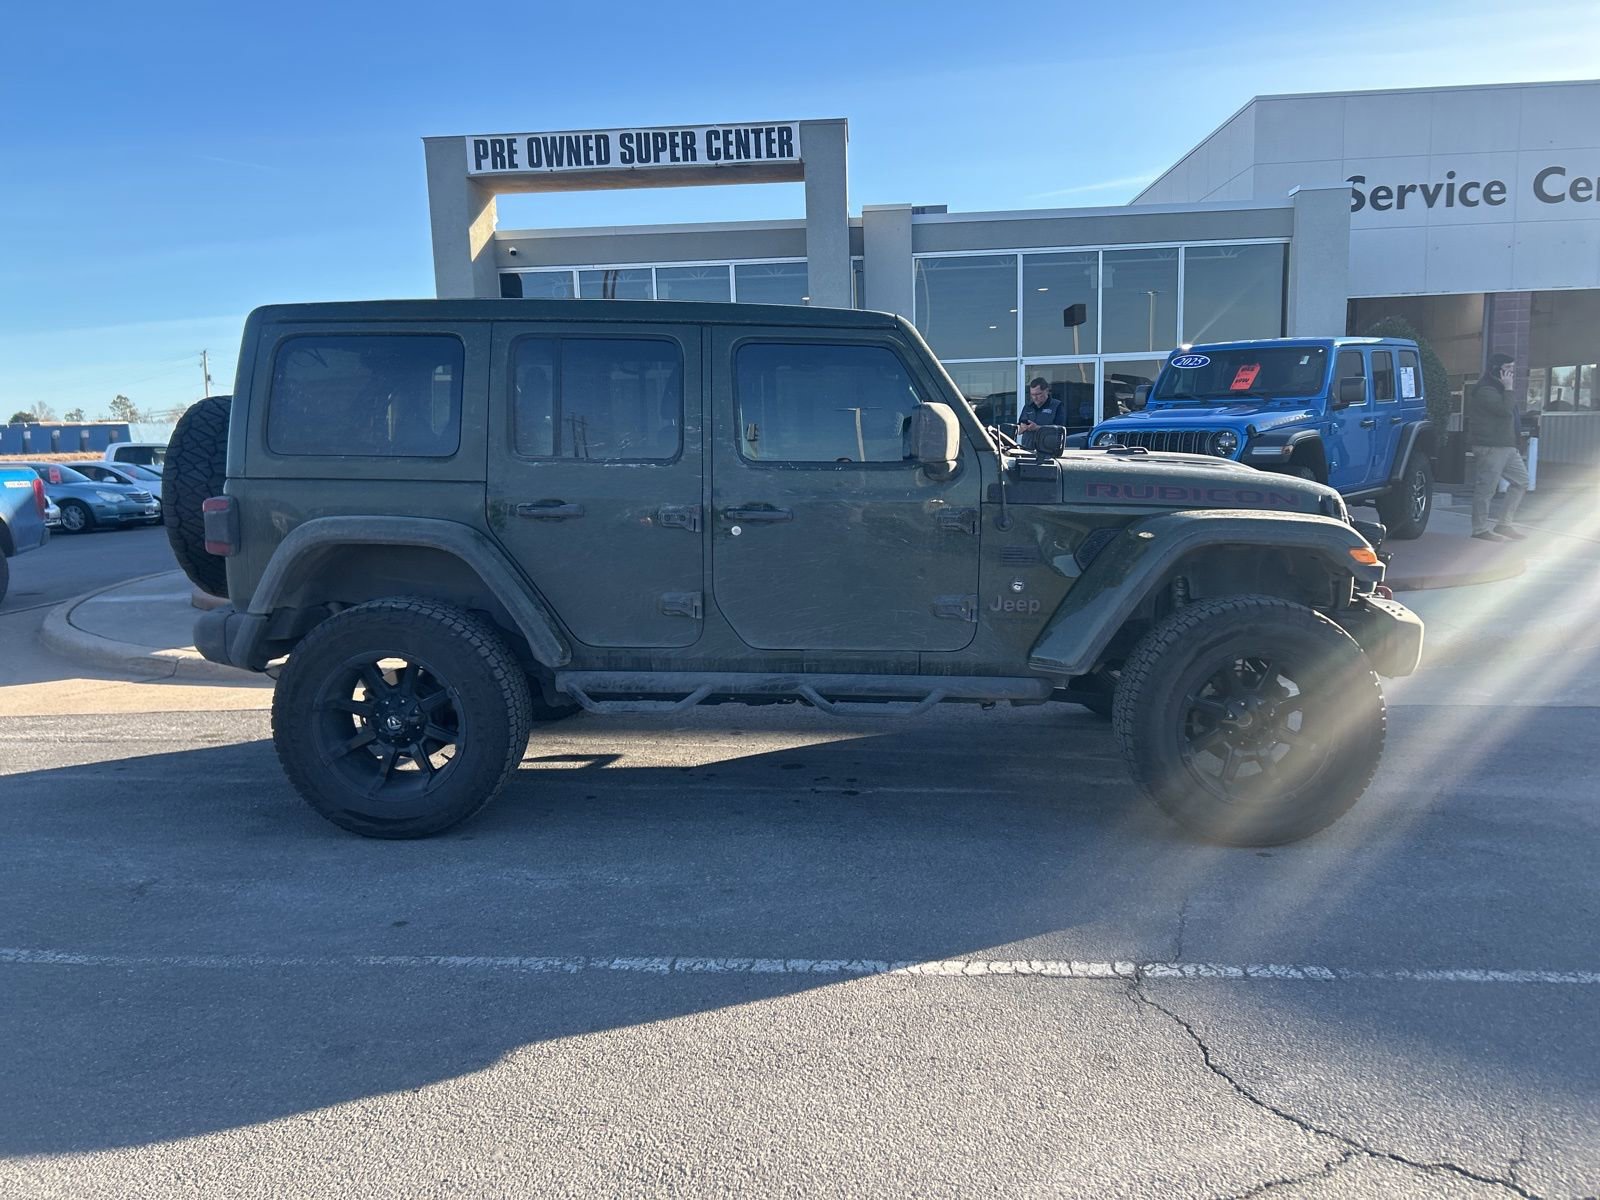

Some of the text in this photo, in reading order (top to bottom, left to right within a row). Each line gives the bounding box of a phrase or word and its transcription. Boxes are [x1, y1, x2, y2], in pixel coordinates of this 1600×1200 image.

[473, 126, 794, 170] PRE OWNED SUPER CENTER
[1346, 166, 1600, 213] Service Ce
[1176, 357, 1205, 366] 2025
[1086, 482, 1301, 506] RUBICON
[989, 594, 1041, 615] Jeep
